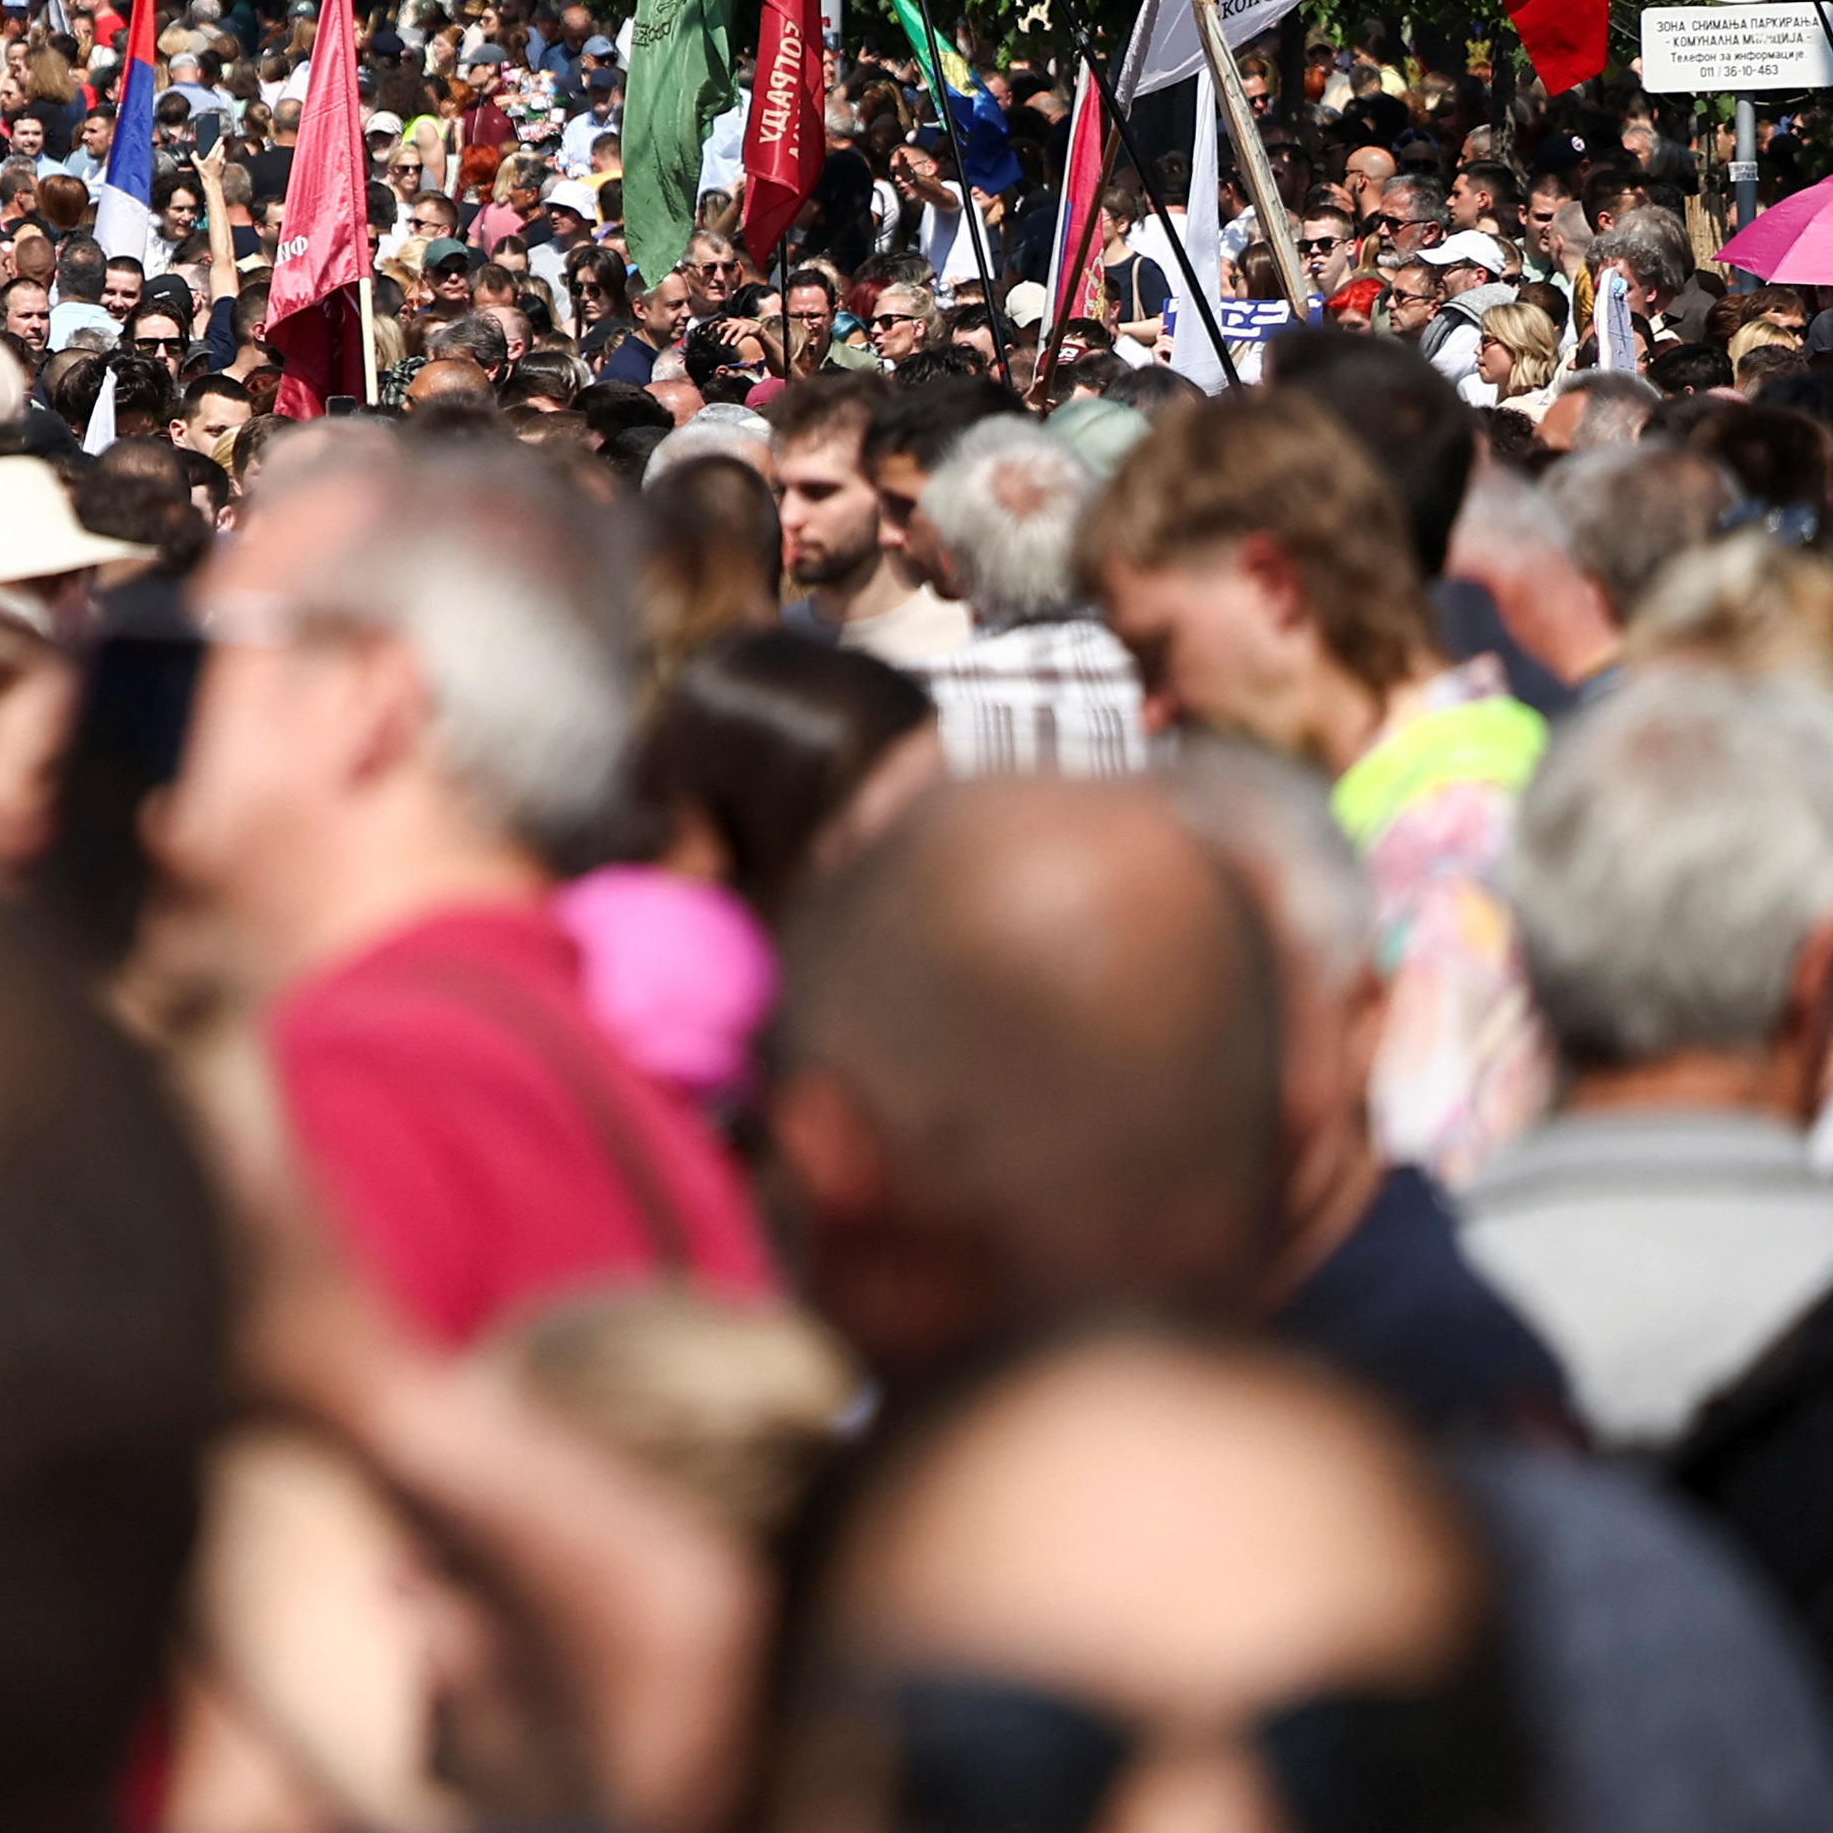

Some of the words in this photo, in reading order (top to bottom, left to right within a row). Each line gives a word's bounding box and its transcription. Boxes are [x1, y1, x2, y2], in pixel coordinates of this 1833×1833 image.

[1656, 20, 1686, 33] ЗОНА
[1691, 18, 1747, 32] СНИМАЊА
[1750, 16, 1820, 30] ПАРКИРАЊА
[1672, 34, 1740, 48] КОМУНАЛНА
[1670, 52, 1717, 64] Телефон
[1719, 53, 1732, 62] за
